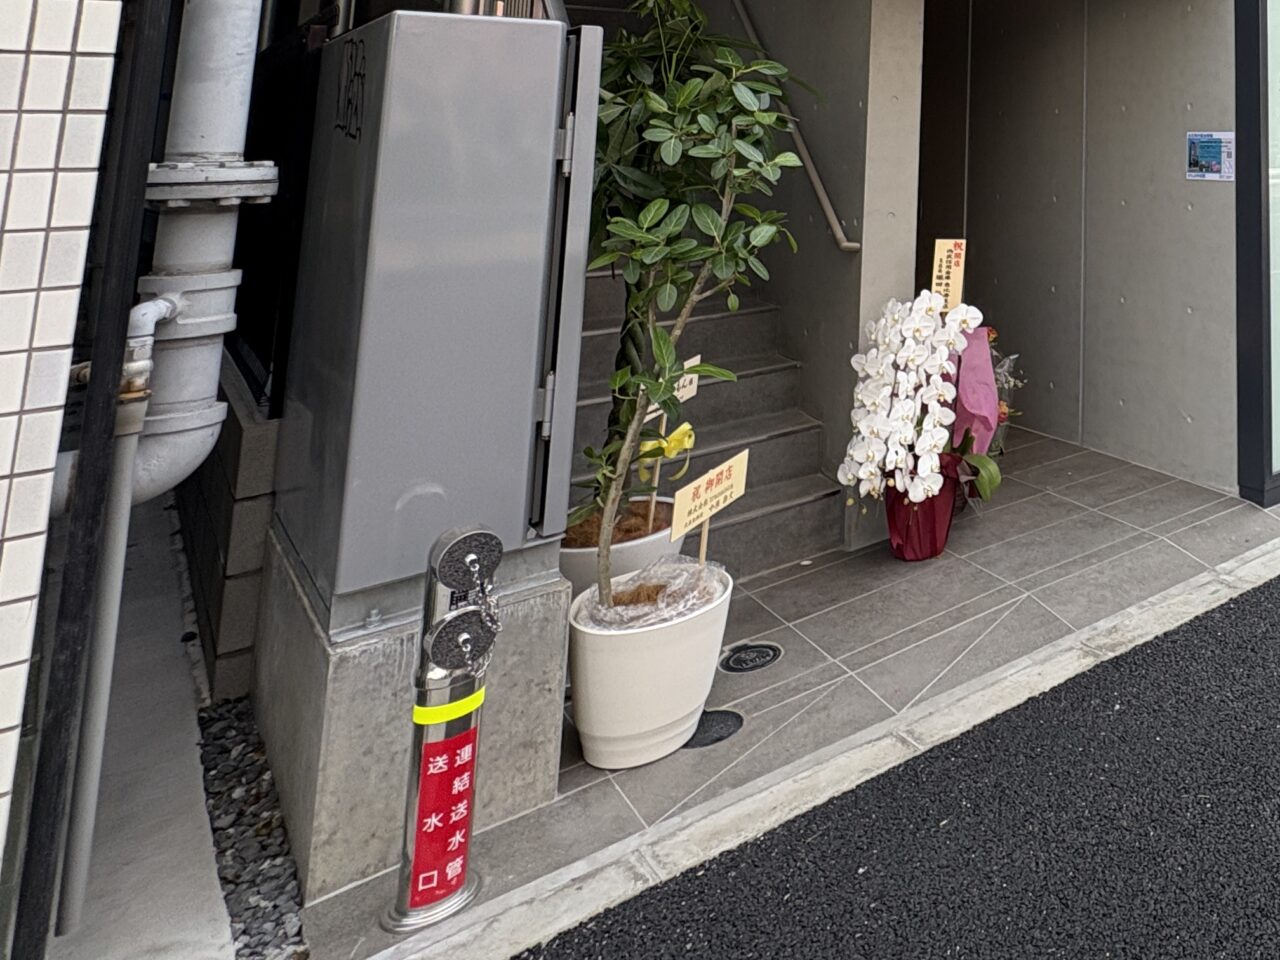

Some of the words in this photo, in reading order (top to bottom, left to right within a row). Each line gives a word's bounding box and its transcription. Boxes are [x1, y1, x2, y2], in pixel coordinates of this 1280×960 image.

[418, 754, 448, 891] 送水口
[446, 743, 473, 880] 連結送水管
